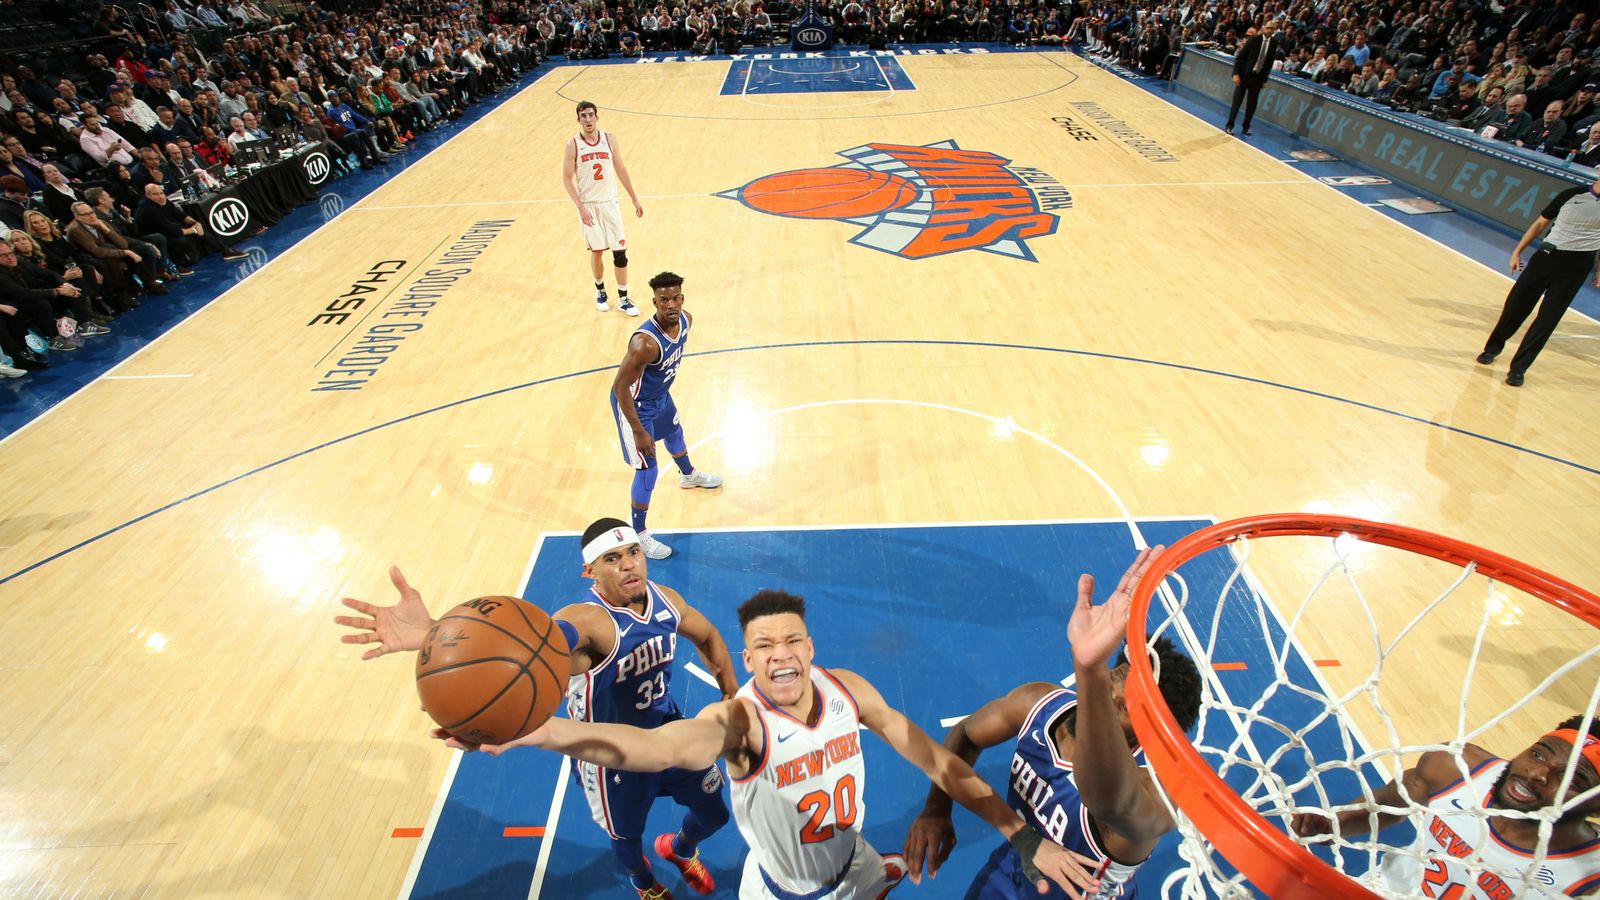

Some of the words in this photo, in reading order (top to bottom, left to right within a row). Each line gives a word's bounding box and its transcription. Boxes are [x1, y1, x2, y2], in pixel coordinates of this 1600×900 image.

[635, 55, 708, 64] NEW
[730, 52, 826, 61] YORK
[849, 48, 990, 57] KNICKS
[802, 31, 822, 42] KIA
[1051, 116, 1099, 142] CHASE
[305, 157, 327, 181] KIA
[592, 162, 604, 181] 2
[1294, 100, 1374, 150] YORK'S
[1374, 131, 1445, 182] REAL
[1450, 161, 1559, 219] ESTA
[213, 203, 246, 232] KIA
[866, 143, 1058, 259] KNICKS
[1033, 185, 1073, 212] YORK
[435, 219, 516, 265] MADISON
[306, 260, 408, 327] CHASE
[381, 267, 473, 319] SQUARE
[310, 323, 425, 392] GARDEN
[659, 345, 684, 370] PHIL
[635, 671, 666, 711] 33
[775, 749, 824, 790] NEW
[823, 730, 861, 770] YORK
[796, 773, 858, 845] 20
[1011, 751, 1070, 847] PHILA
[1429, 814, 1474, 859] NEW
